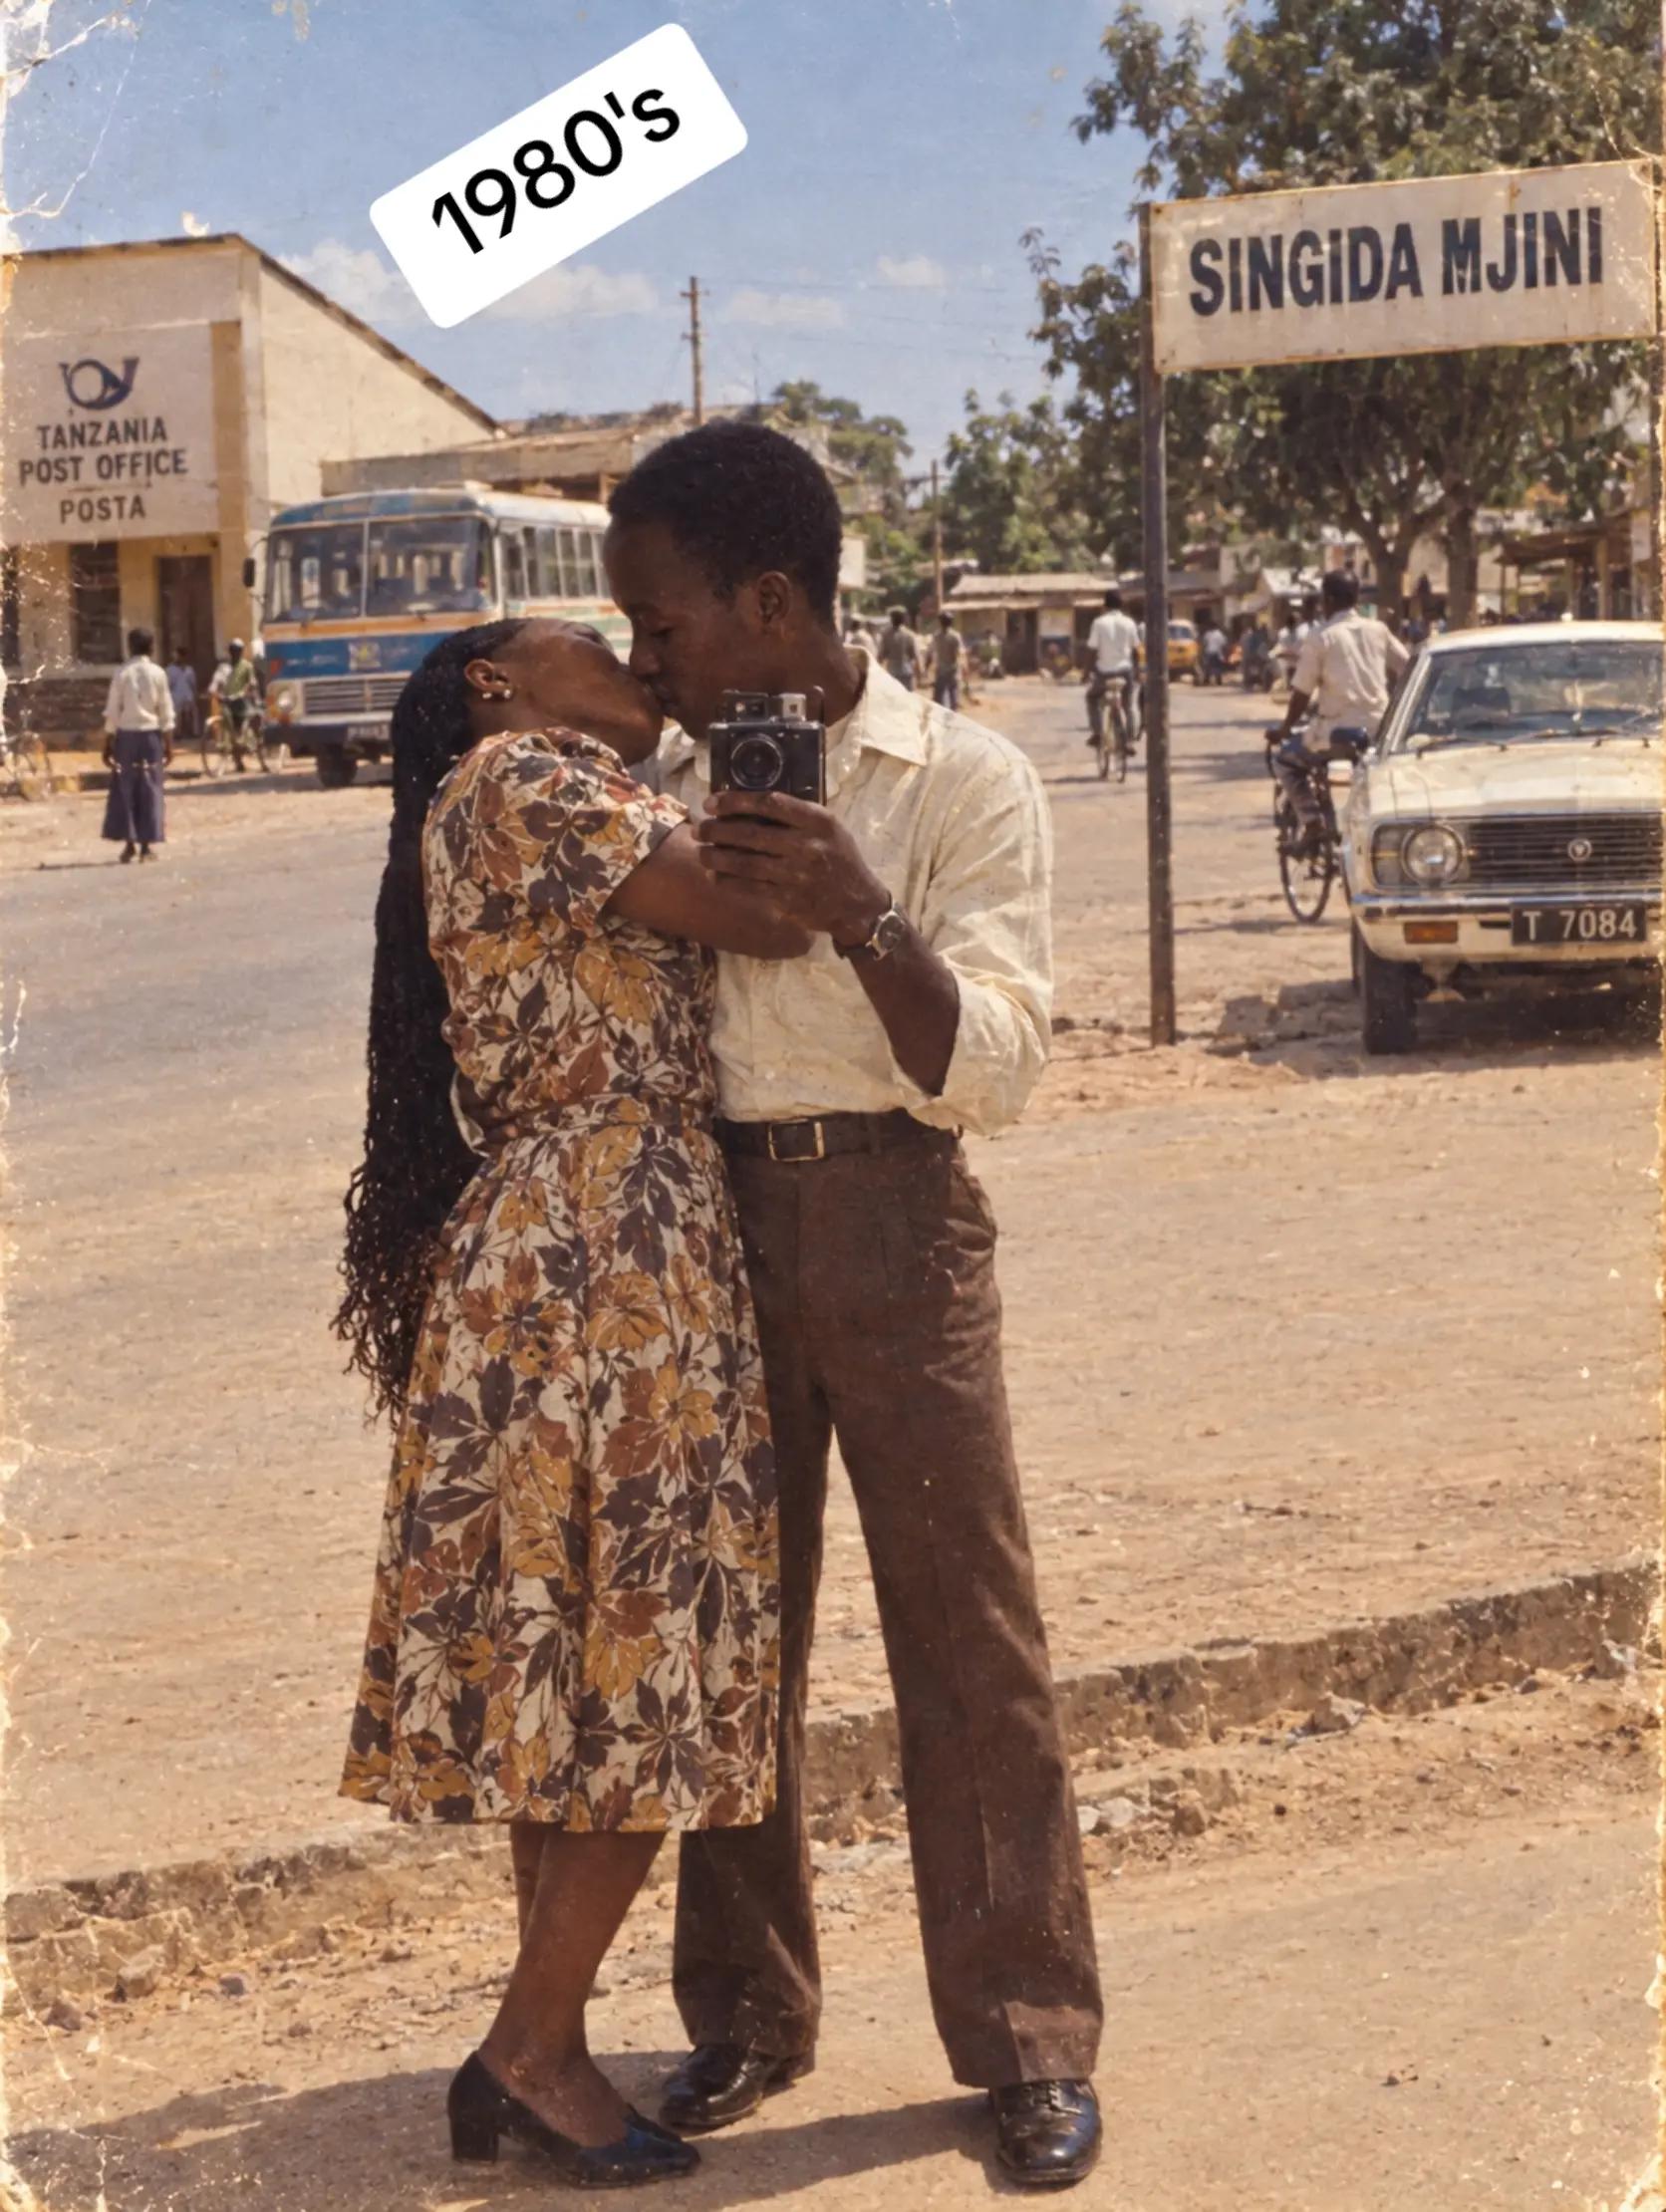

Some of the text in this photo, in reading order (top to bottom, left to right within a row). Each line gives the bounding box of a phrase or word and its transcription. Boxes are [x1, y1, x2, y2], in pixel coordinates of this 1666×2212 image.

[1189, 205, 1603, 317] SINGIDA MJINI
[37, 415, 167, 449] TANZANIA
[18, 448, 188, 487] POST OFFICE
[60, 494, 146, 525] POSTA
[1522, 908, 1637, 942] T 7084
